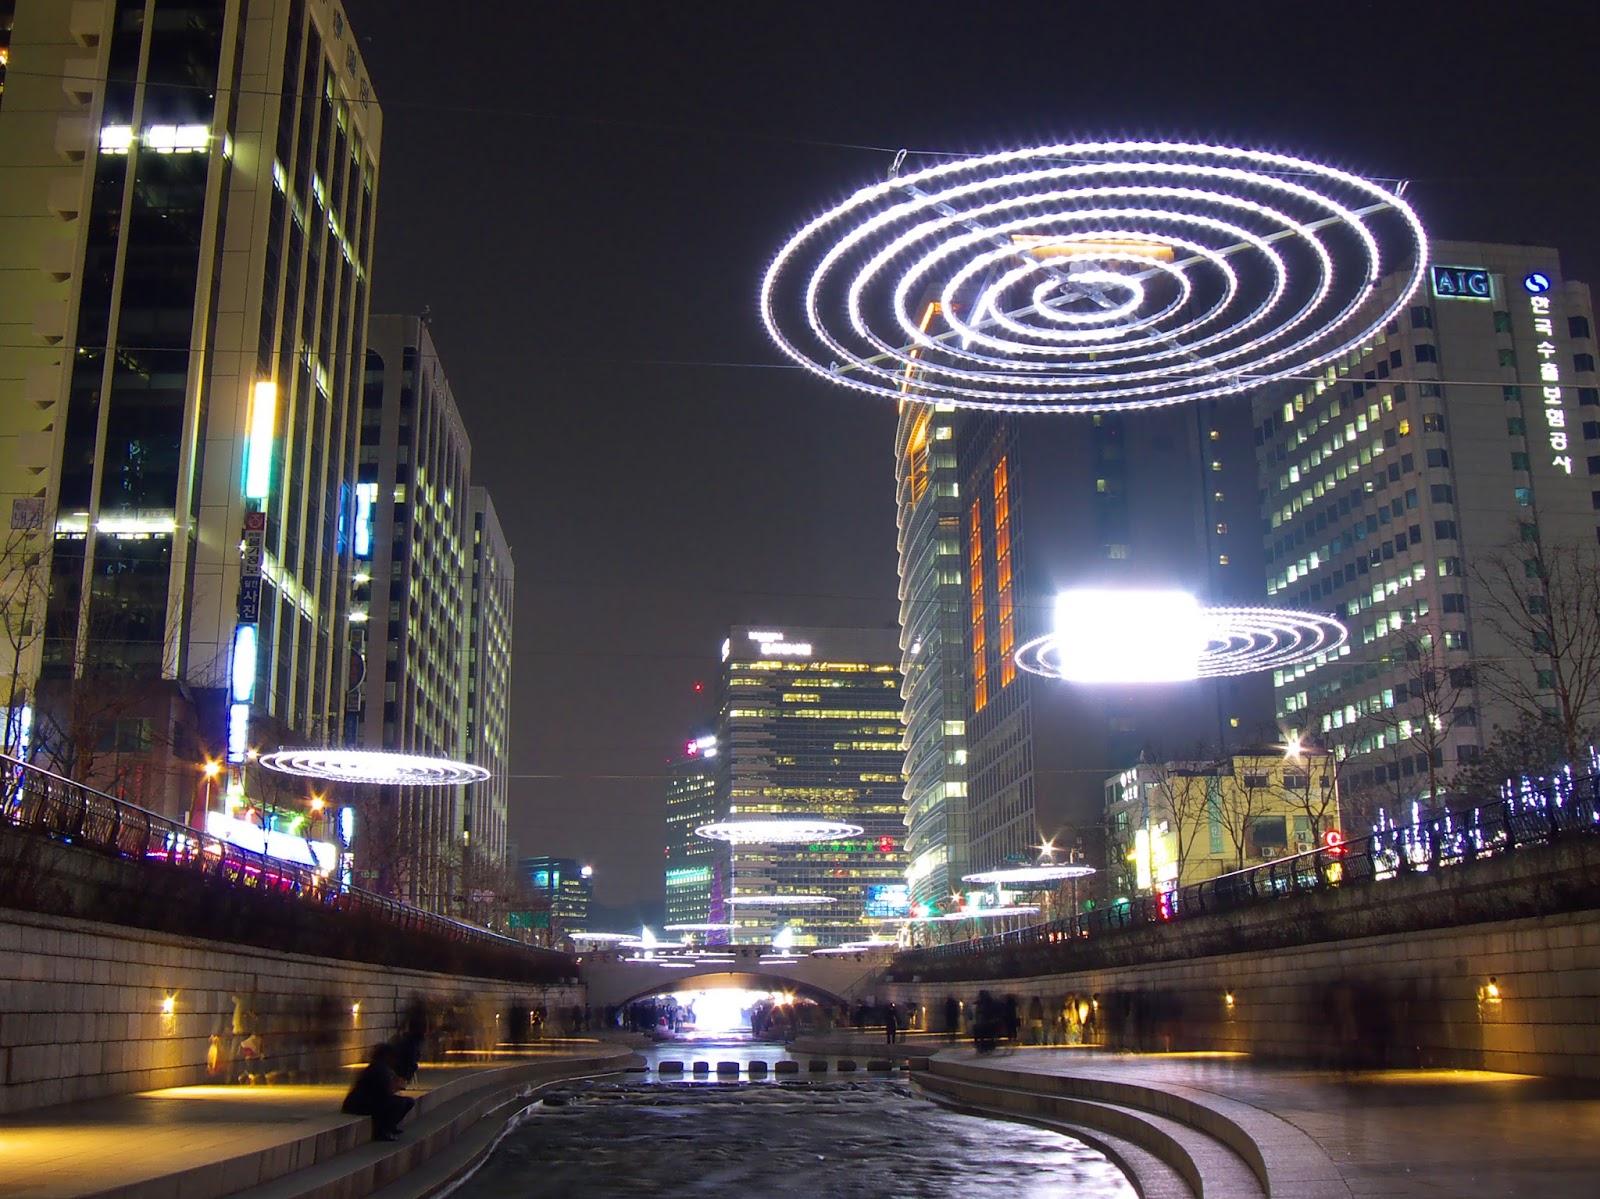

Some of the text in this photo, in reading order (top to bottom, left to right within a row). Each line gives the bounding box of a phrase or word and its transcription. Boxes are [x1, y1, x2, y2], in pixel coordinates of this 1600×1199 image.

[1439, 271, 1488, 294] AIG
[1530, 295, 1572, 475] 한국수출보험공사
[243, 591, 258, 618] 사진
